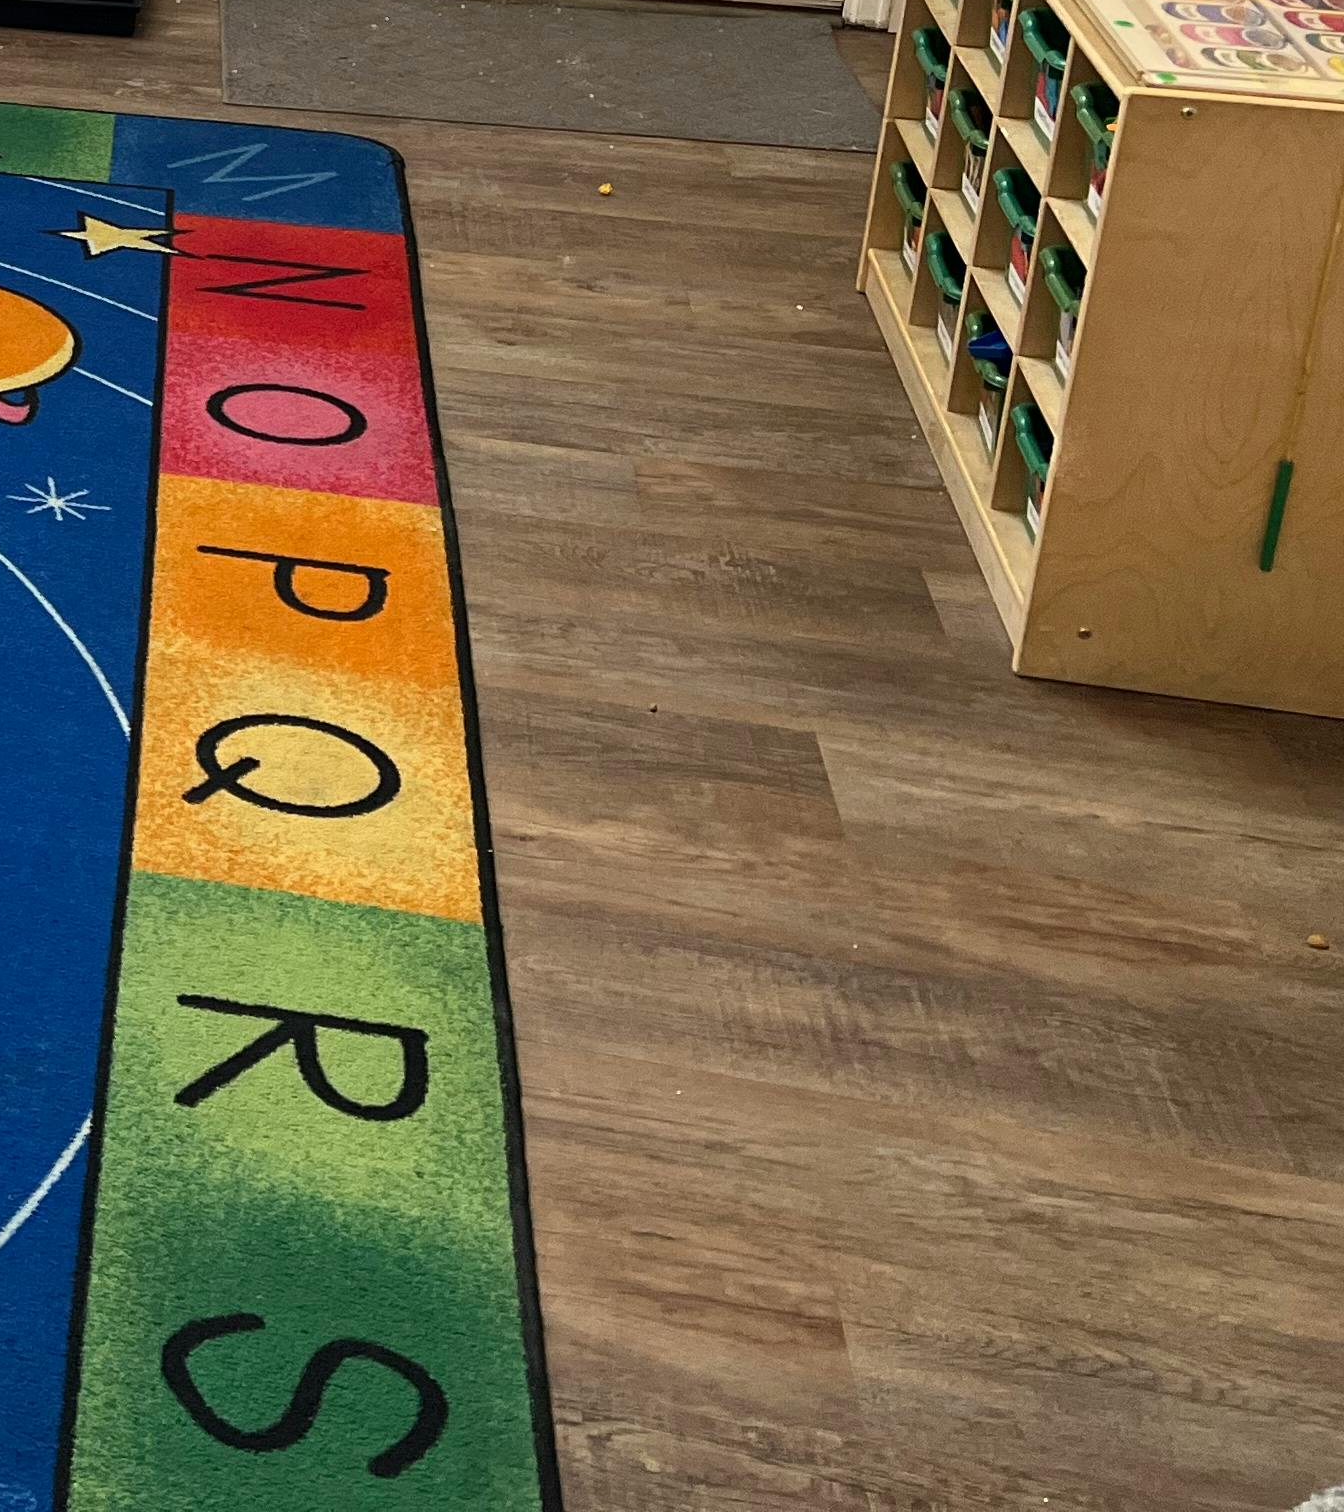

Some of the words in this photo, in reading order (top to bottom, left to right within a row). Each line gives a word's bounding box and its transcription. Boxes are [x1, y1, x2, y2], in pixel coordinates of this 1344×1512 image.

[166, 143, 341, 201] M
[195, 253, 373, 311] N
[205, 384, 369, 446] O
[197, 543, 390, 622] P
[182, 713, 403, 820] Q
[176, 992, 430, 1123] R
[160, 1311, 449, 1480] S
